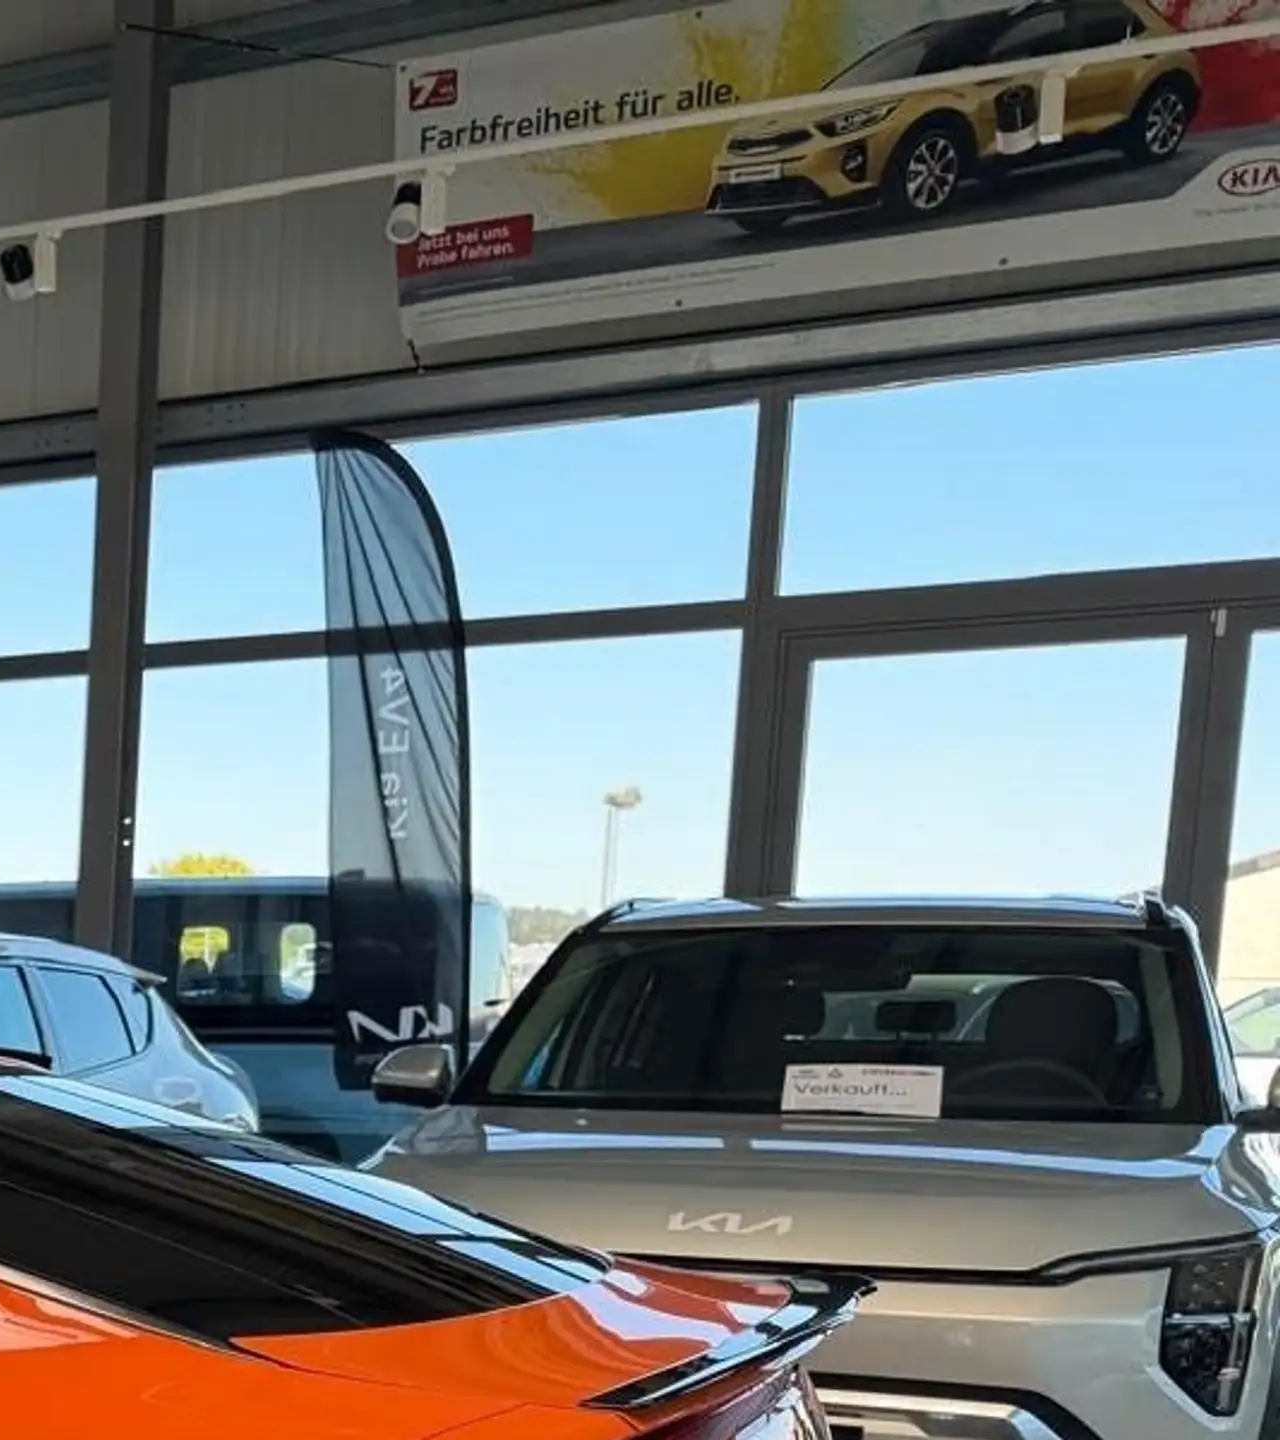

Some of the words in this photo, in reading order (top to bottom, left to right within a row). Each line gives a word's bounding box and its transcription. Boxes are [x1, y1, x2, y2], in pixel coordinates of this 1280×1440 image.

[420, 101, 604, 153] Farbfreiheit
[617, 91, 667, 122] für
[677, 79, 741, 111] alle.
[1230, 164, 1280, 188] KIA
[456, 228, 479, 245] bei
[482, 225, 510, 238] uns
[416, 250, 458, 269] Probe
[667, 1212, 793, 1236] KIA
